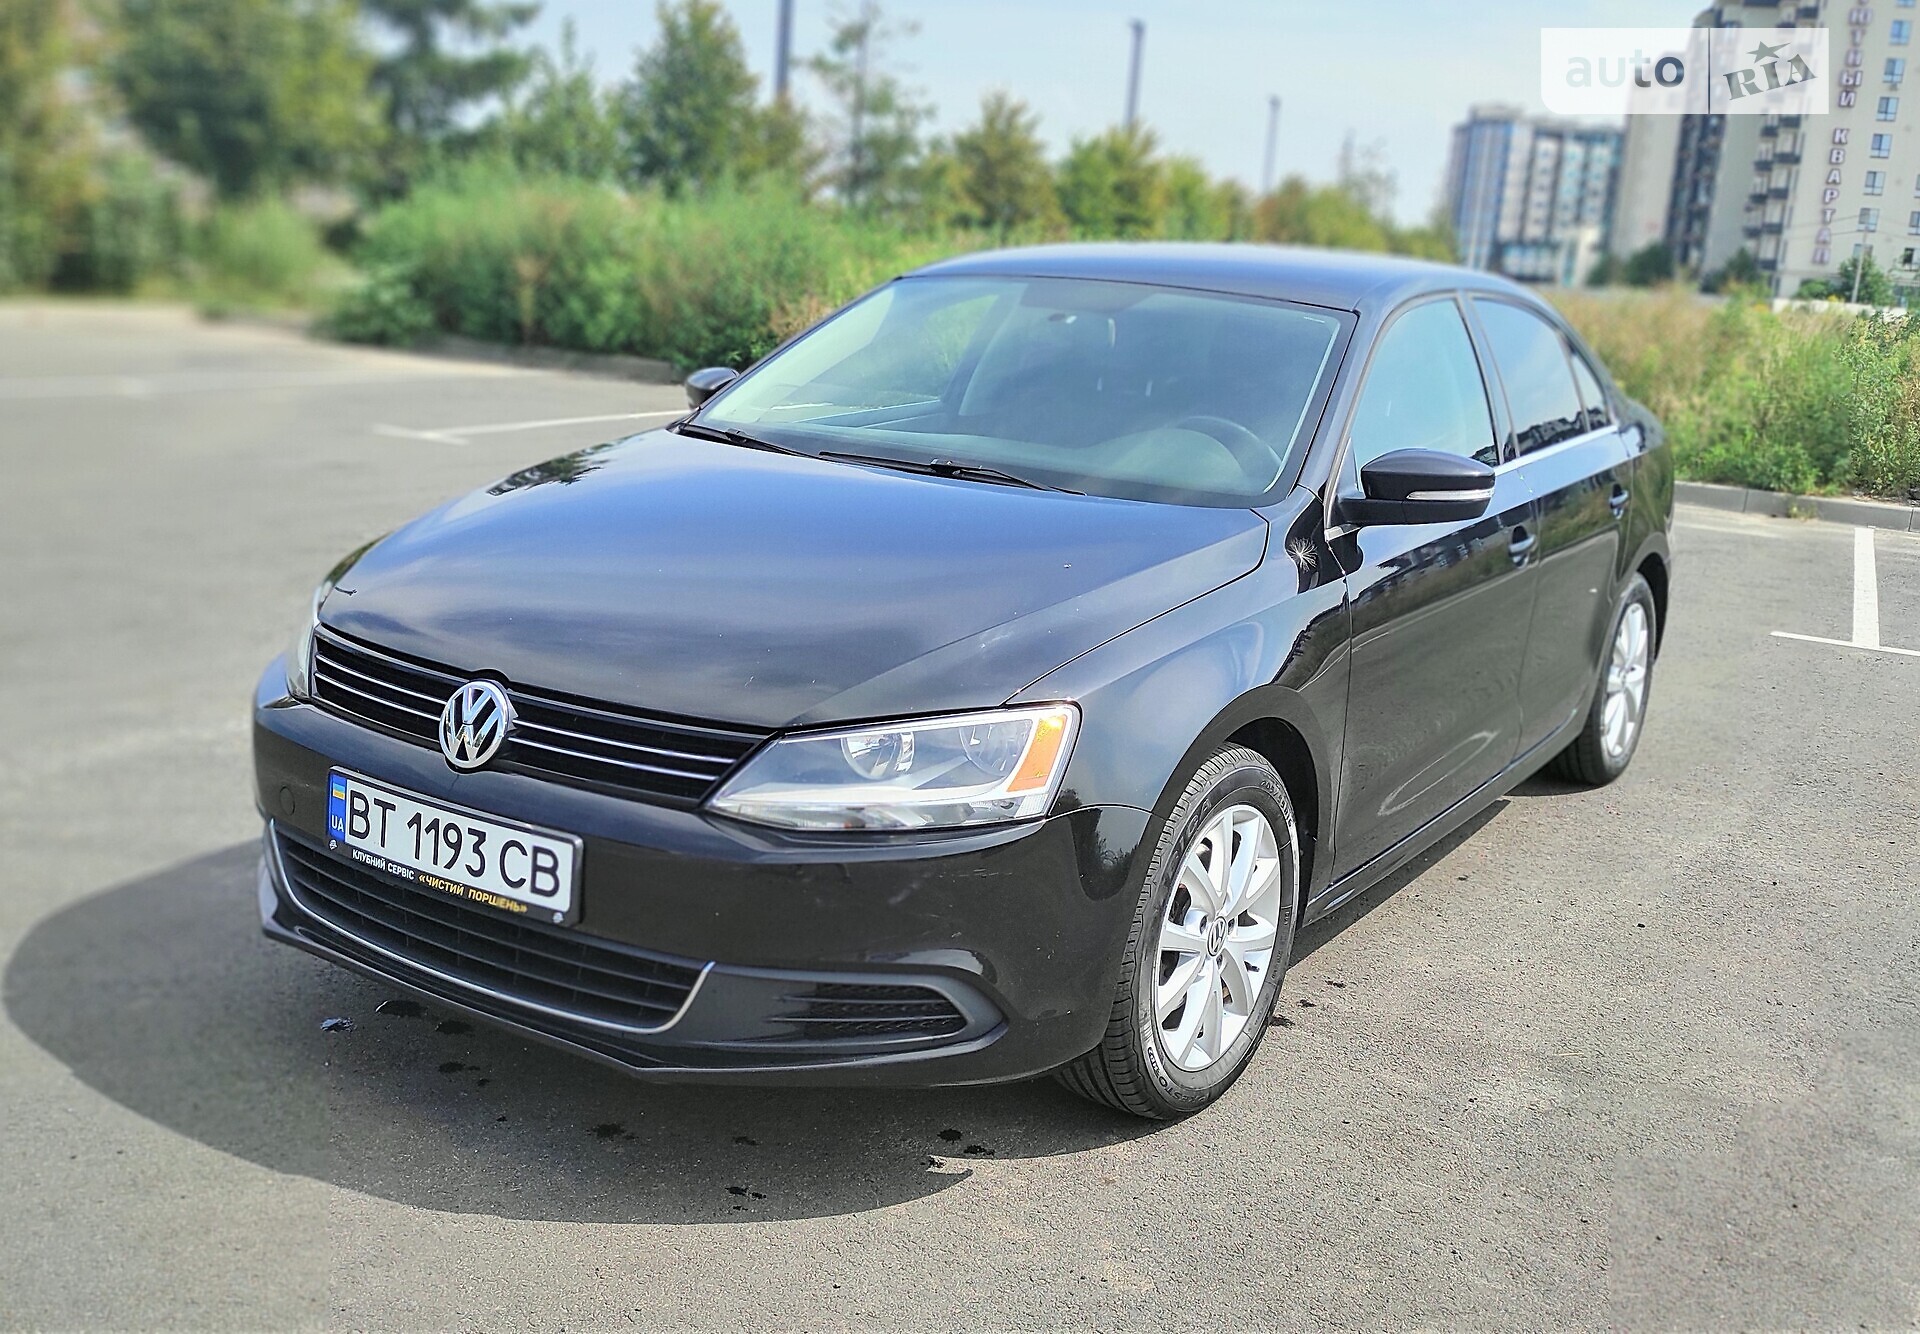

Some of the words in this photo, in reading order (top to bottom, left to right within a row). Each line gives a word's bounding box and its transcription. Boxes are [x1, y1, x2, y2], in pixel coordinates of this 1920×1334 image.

[331, 815, 344, 832] UA
[407, 811, 487, 878] 1193
[352, 849, 386, 871] КЛУБНИЙ
